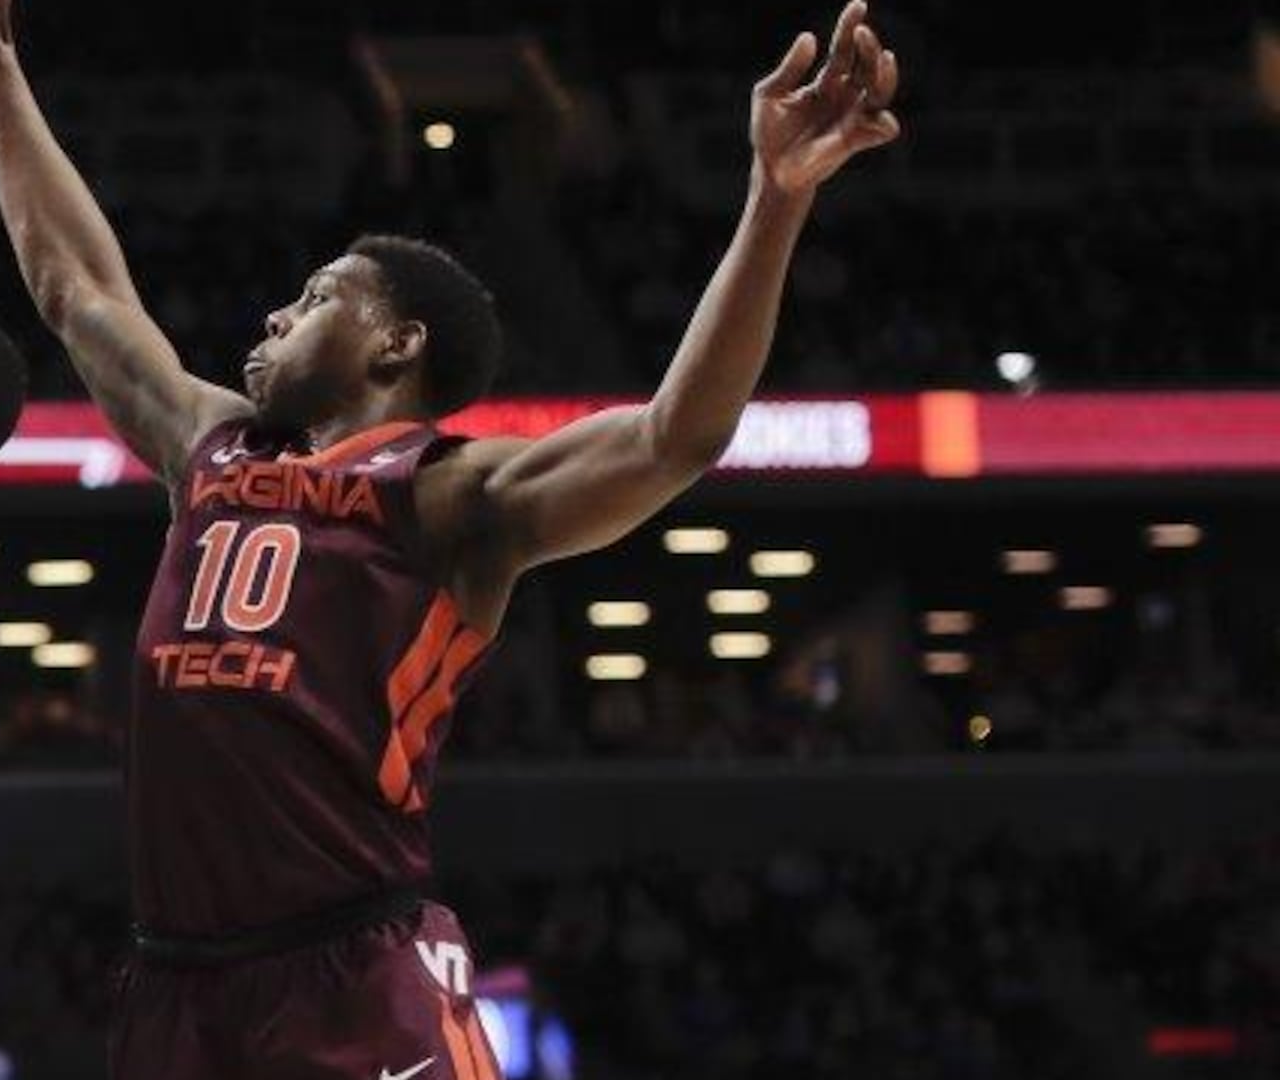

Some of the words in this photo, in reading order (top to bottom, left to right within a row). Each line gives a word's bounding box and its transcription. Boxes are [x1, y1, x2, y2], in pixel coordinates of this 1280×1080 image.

[189, 462, 384, 525] VRGINIA
[183, 520, 301, 632] 10
[151, 641, 297, 692] TECH
